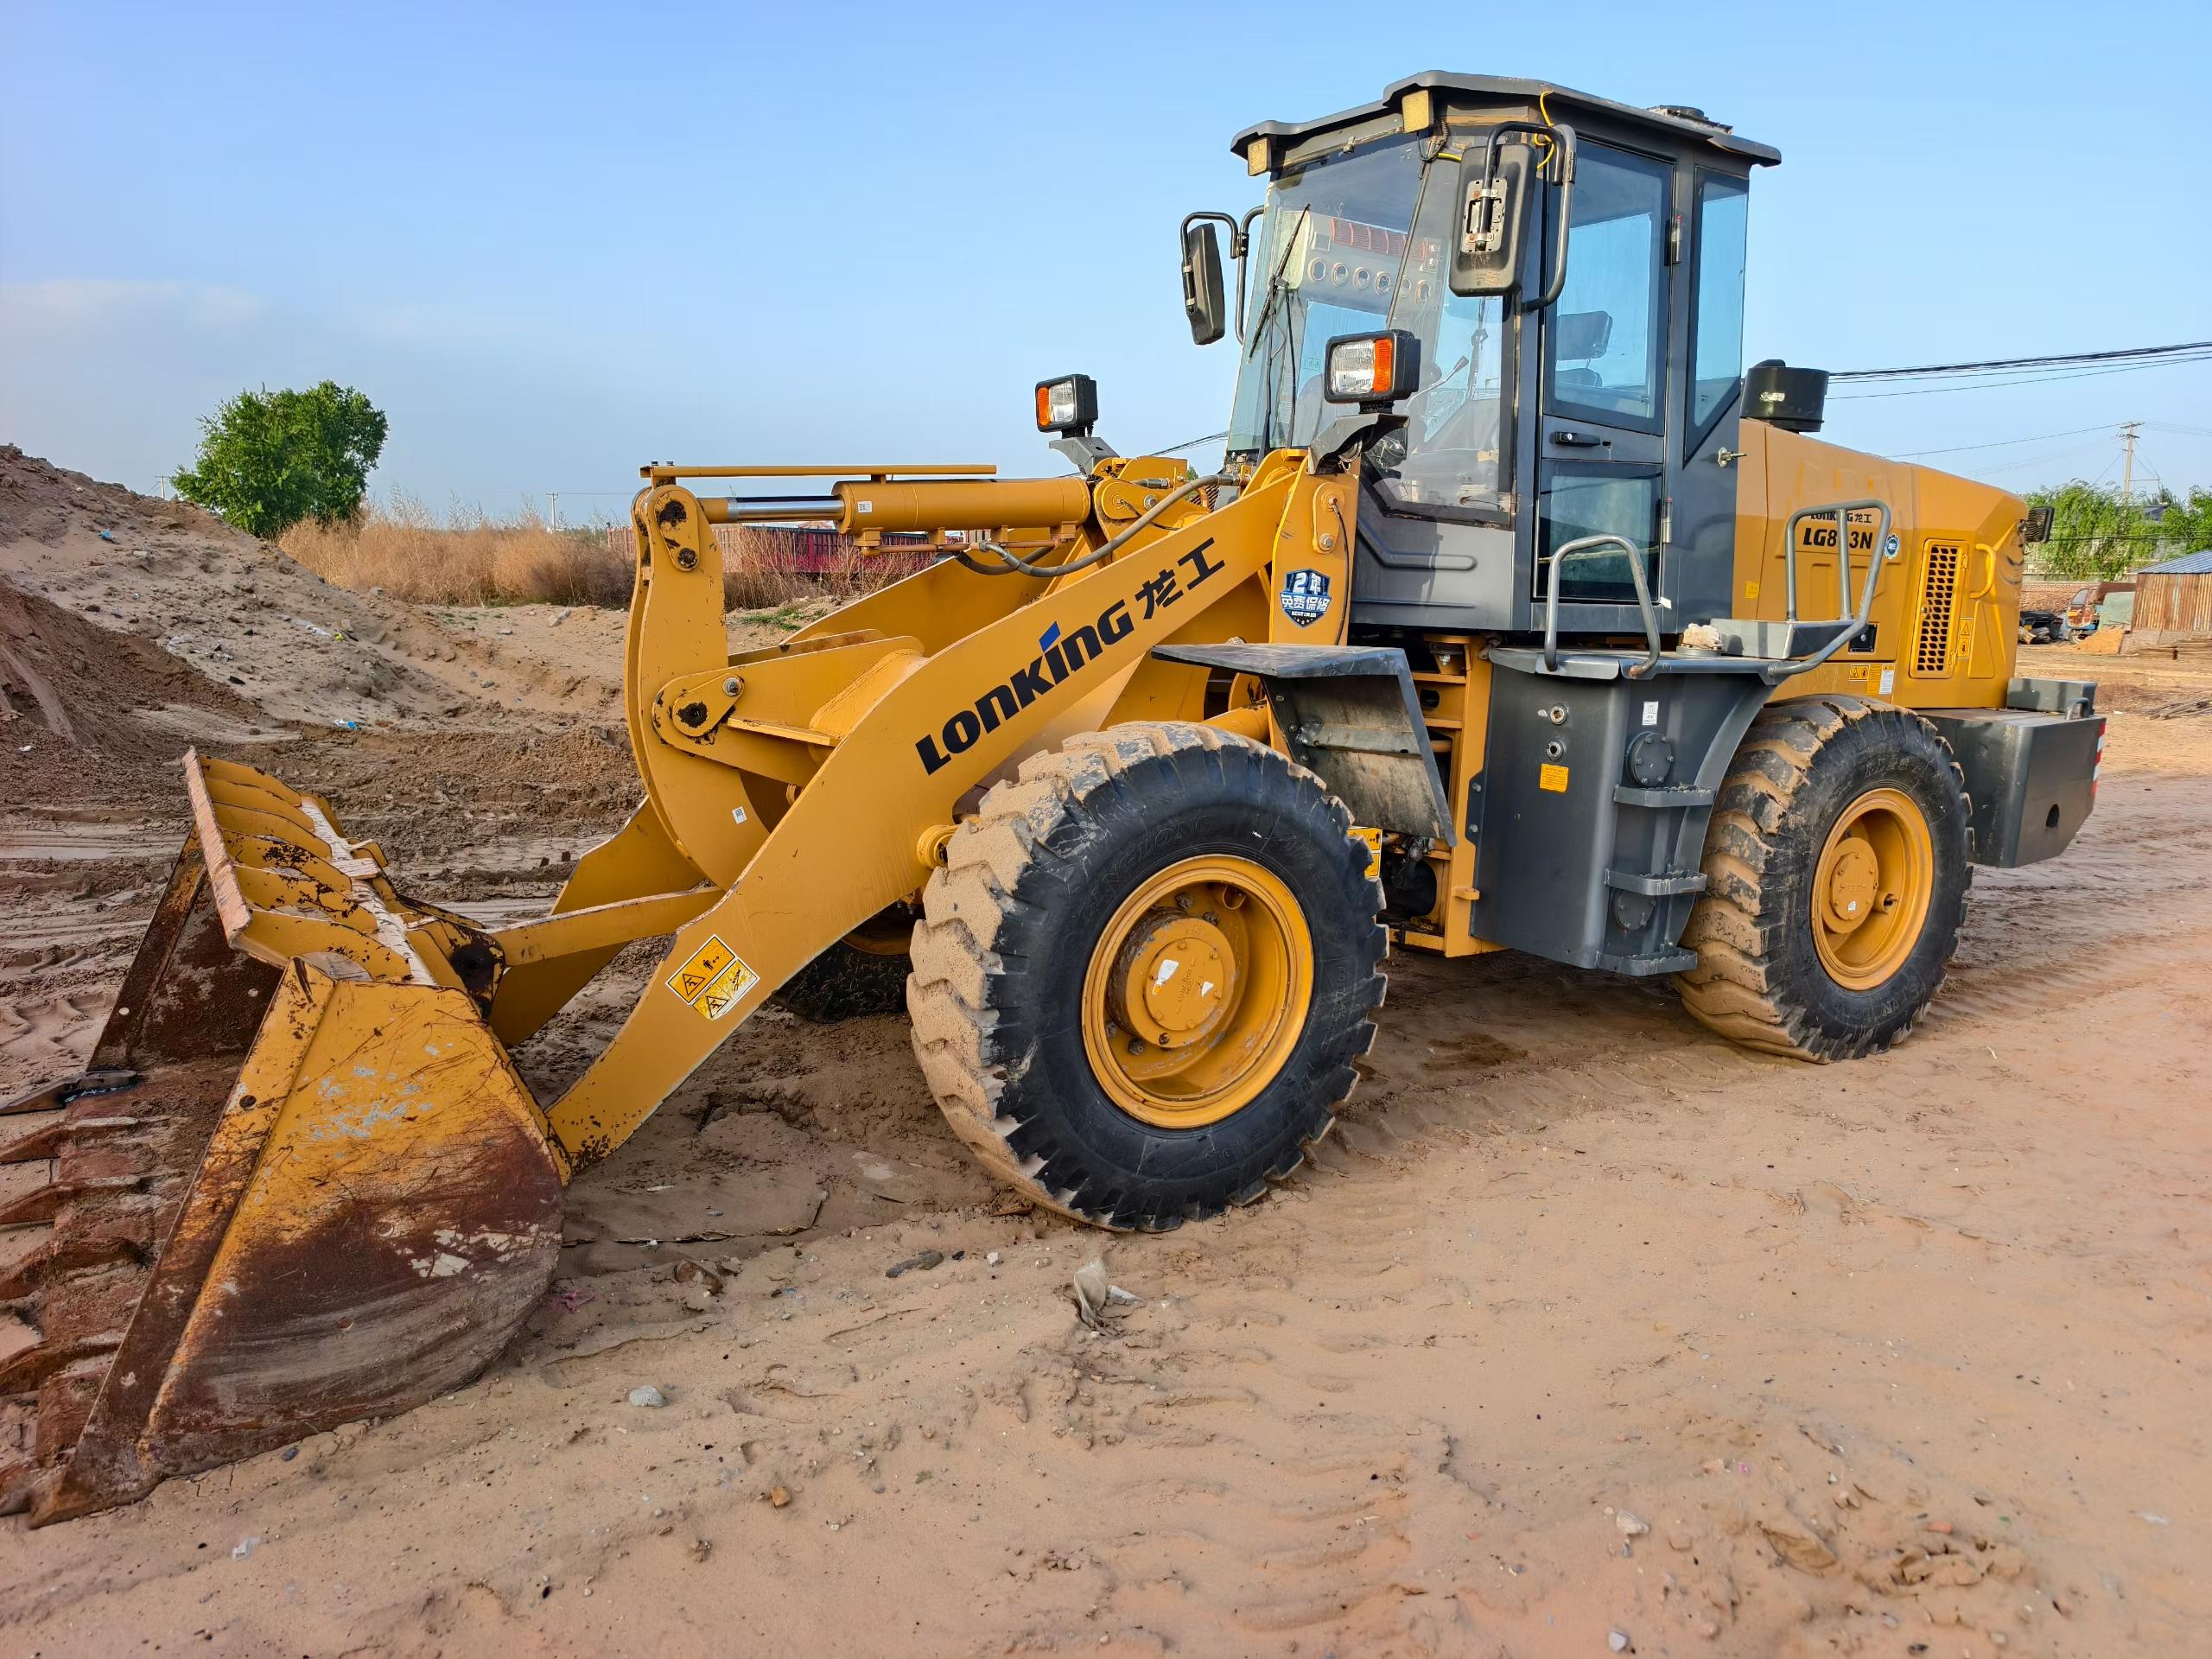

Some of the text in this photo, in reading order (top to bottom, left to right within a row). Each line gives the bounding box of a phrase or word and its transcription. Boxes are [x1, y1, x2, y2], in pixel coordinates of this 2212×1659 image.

[1854, 512, 1872, 524] 龙工
[1803, 528, 1872, 549] LG83N
[1135, 537, 1225, 620] 龙工
[1293, 572, 1321, 594] 2年
[1281, 594, 1331, 612] 免费保修
